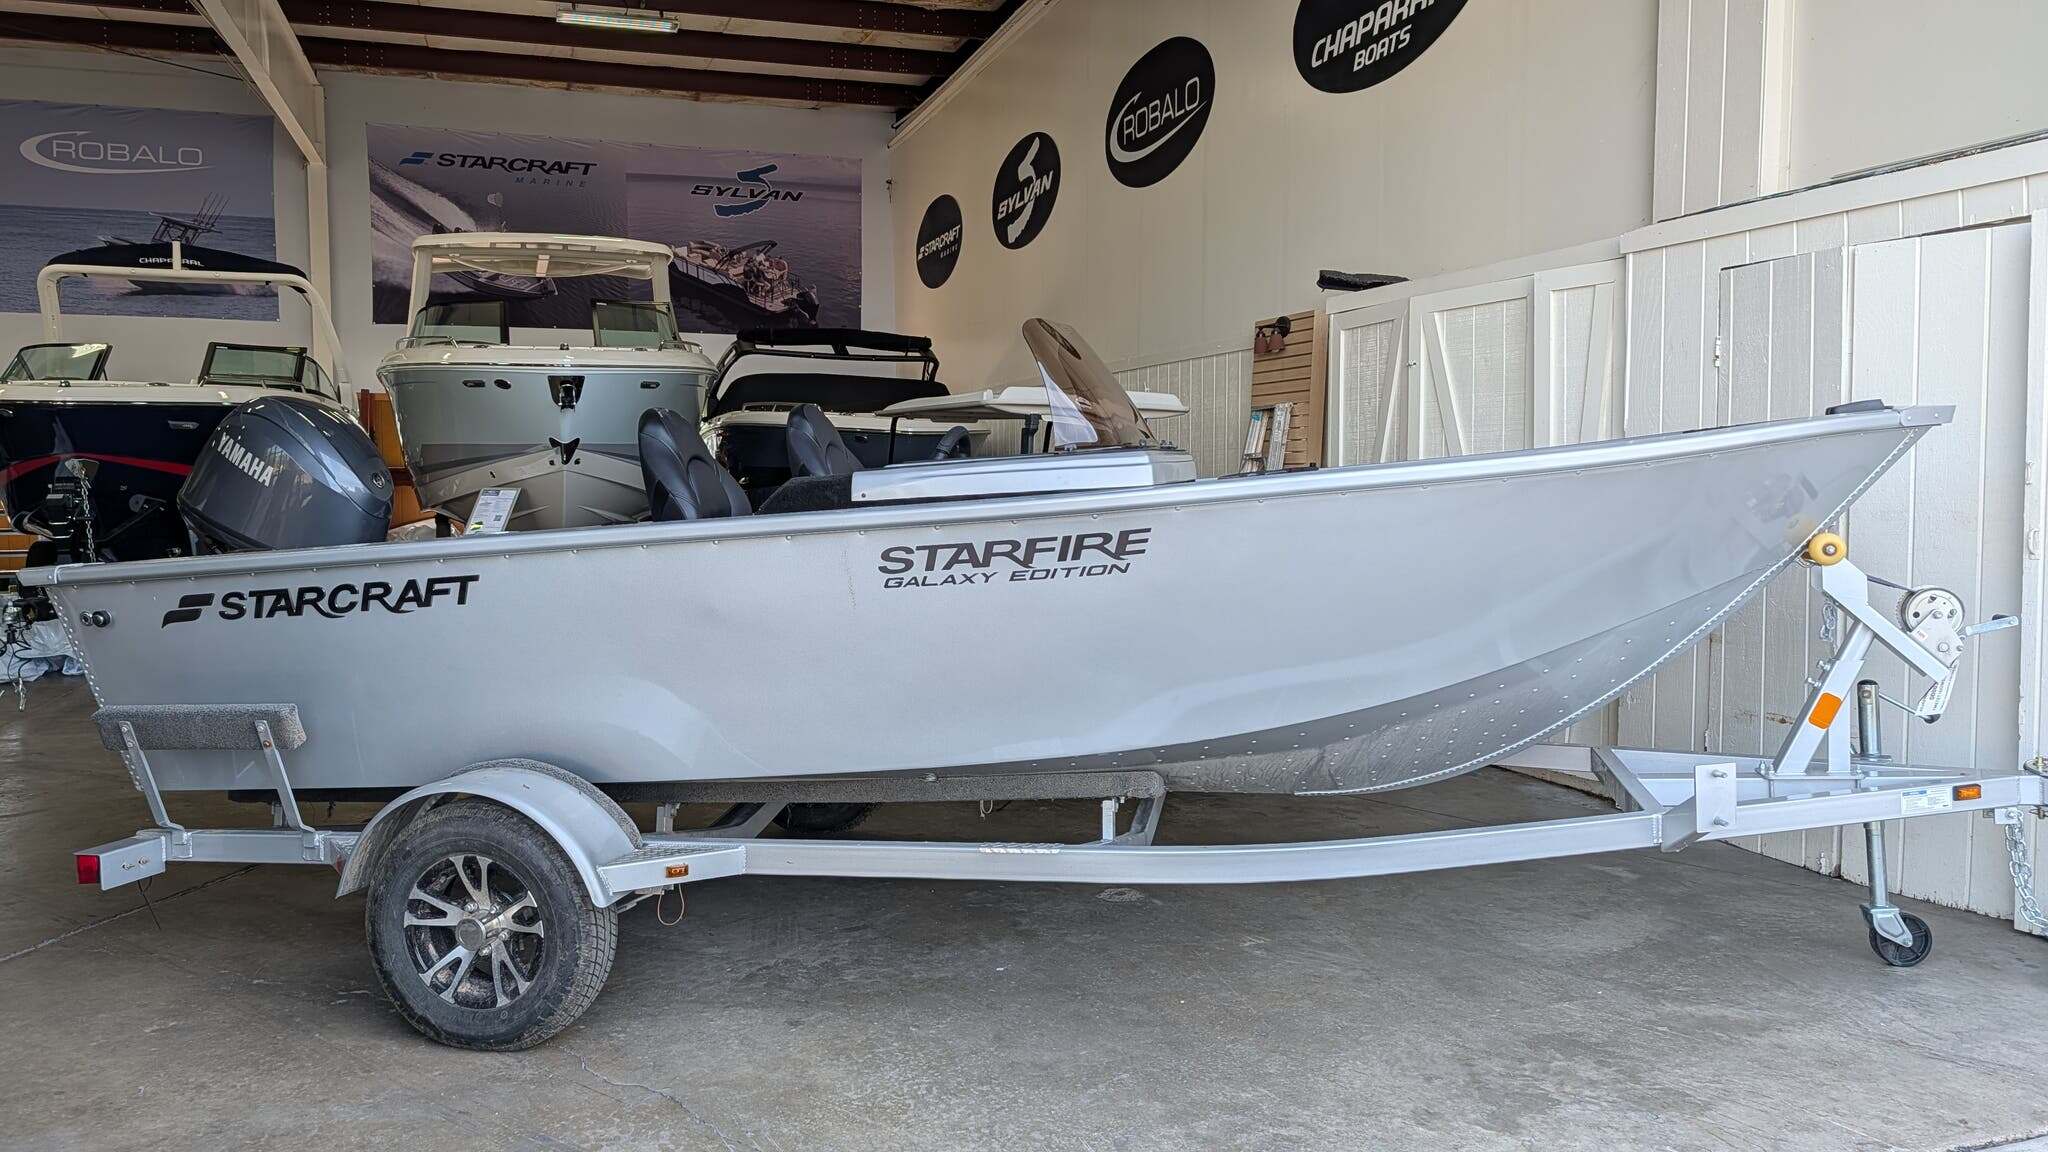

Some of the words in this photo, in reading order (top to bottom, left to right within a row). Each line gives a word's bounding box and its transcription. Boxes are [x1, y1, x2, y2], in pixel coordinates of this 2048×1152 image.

[1353, 24, 1412, 72] BOATS
[1123, 76, 1199, 145] ROBALO
[52, 139, 203, 166] ROBALO
[436, 153, 598, 176] STARCRAFT
[515, 177, 587, 188] MARINE
[691, 184, 803, 202] SYLVAN
[997, 170, 1053, 220] SYLVAN
[924, 224, 960, 257] STARCRAFT
[217, 432, 274, 487] YAMAHA
[878, 528, 1152, 575] STARFIRE
[884, 571, 998, 589] GALAXY
[1009, 563, 1130, 582] EDITION
[218, 574, 480, 620] STARCRAFT
